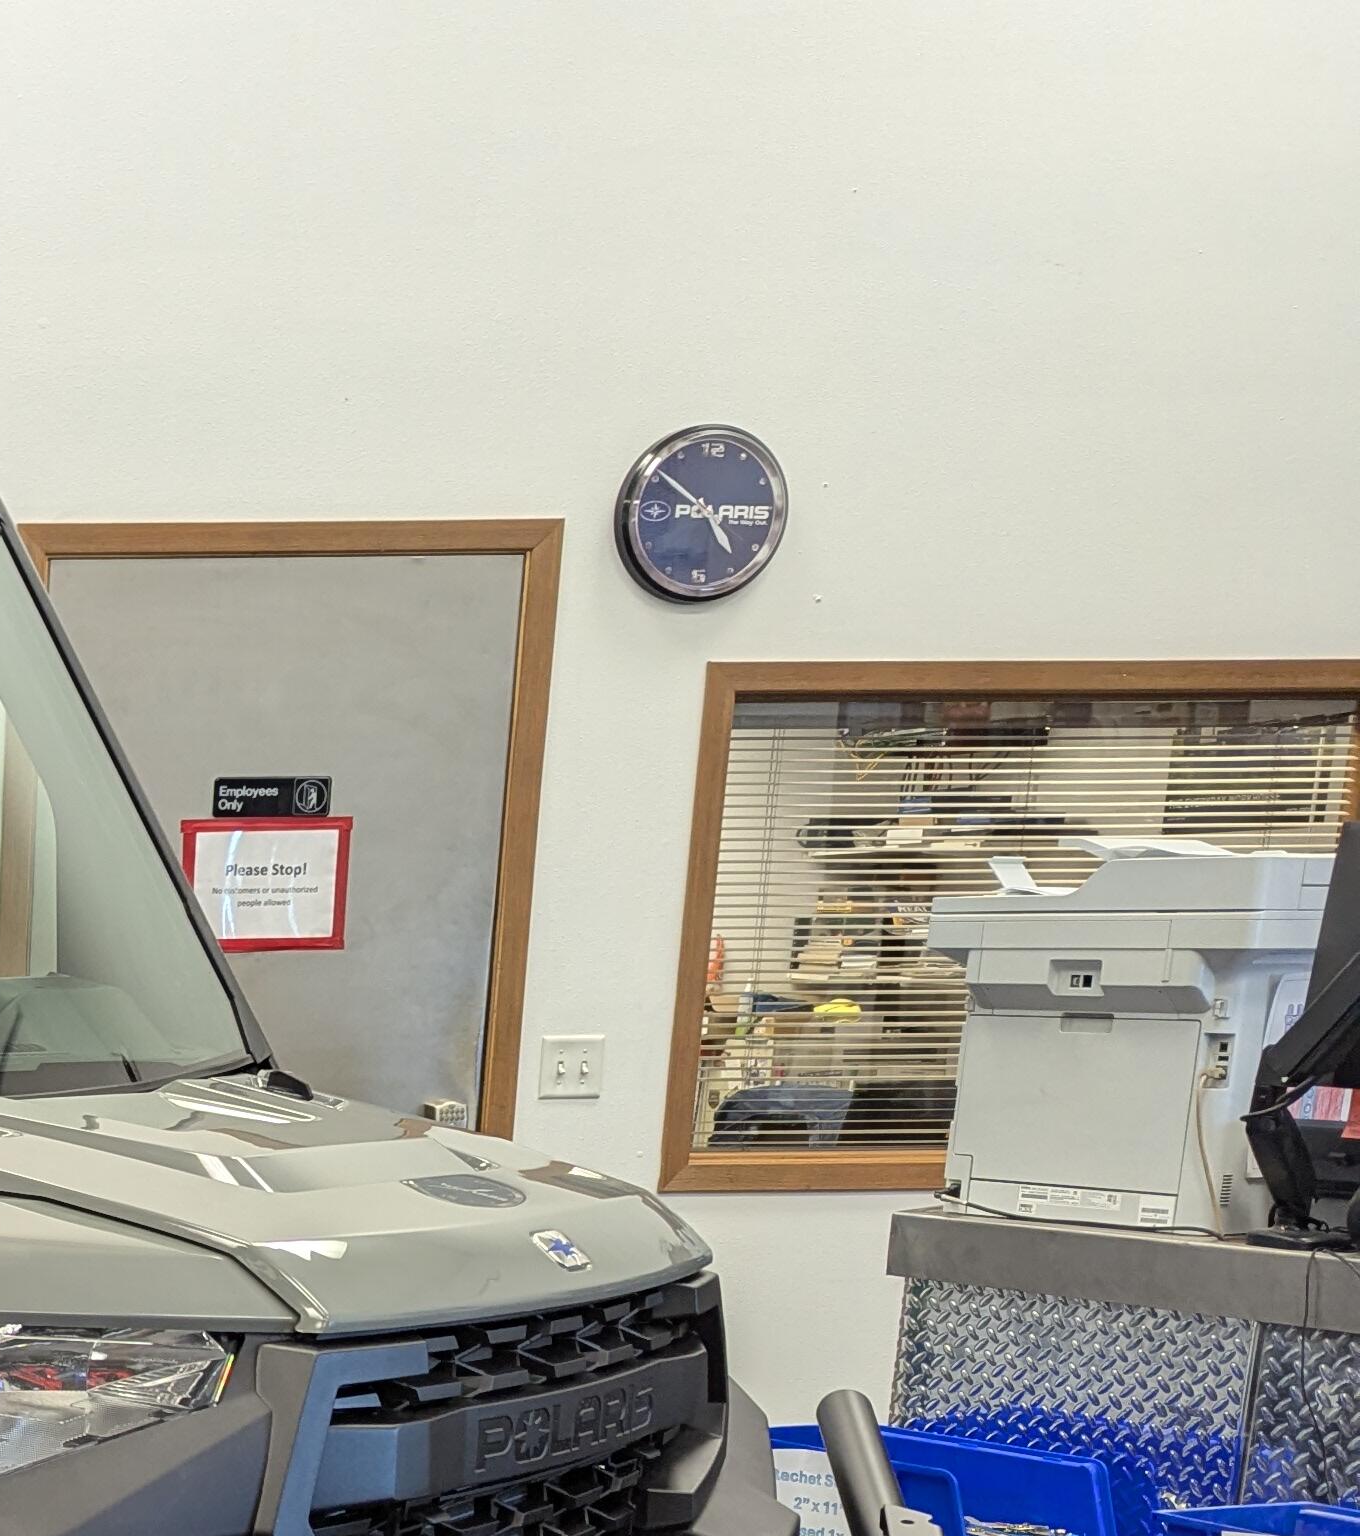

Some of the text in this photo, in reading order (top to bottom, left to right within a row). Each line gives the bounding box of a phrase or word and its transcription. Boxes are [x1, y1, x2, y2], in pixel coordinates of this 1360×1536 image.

[701, 443, 725, 458] 12
[218, 785, 279, 799] Employees
[218, 799, 244, 812] Only
[225, 862, 307, 878] Please Stop!
[212, 887, 223, 895] No
[224, 886, 261, 895] customers
[271, 886, 319, 895] unauthorized
[237, 898, 291, 908] people allowed
[473, 1386, 654, 1474] POLARIS
[811, 1502, 820, 1513] x
